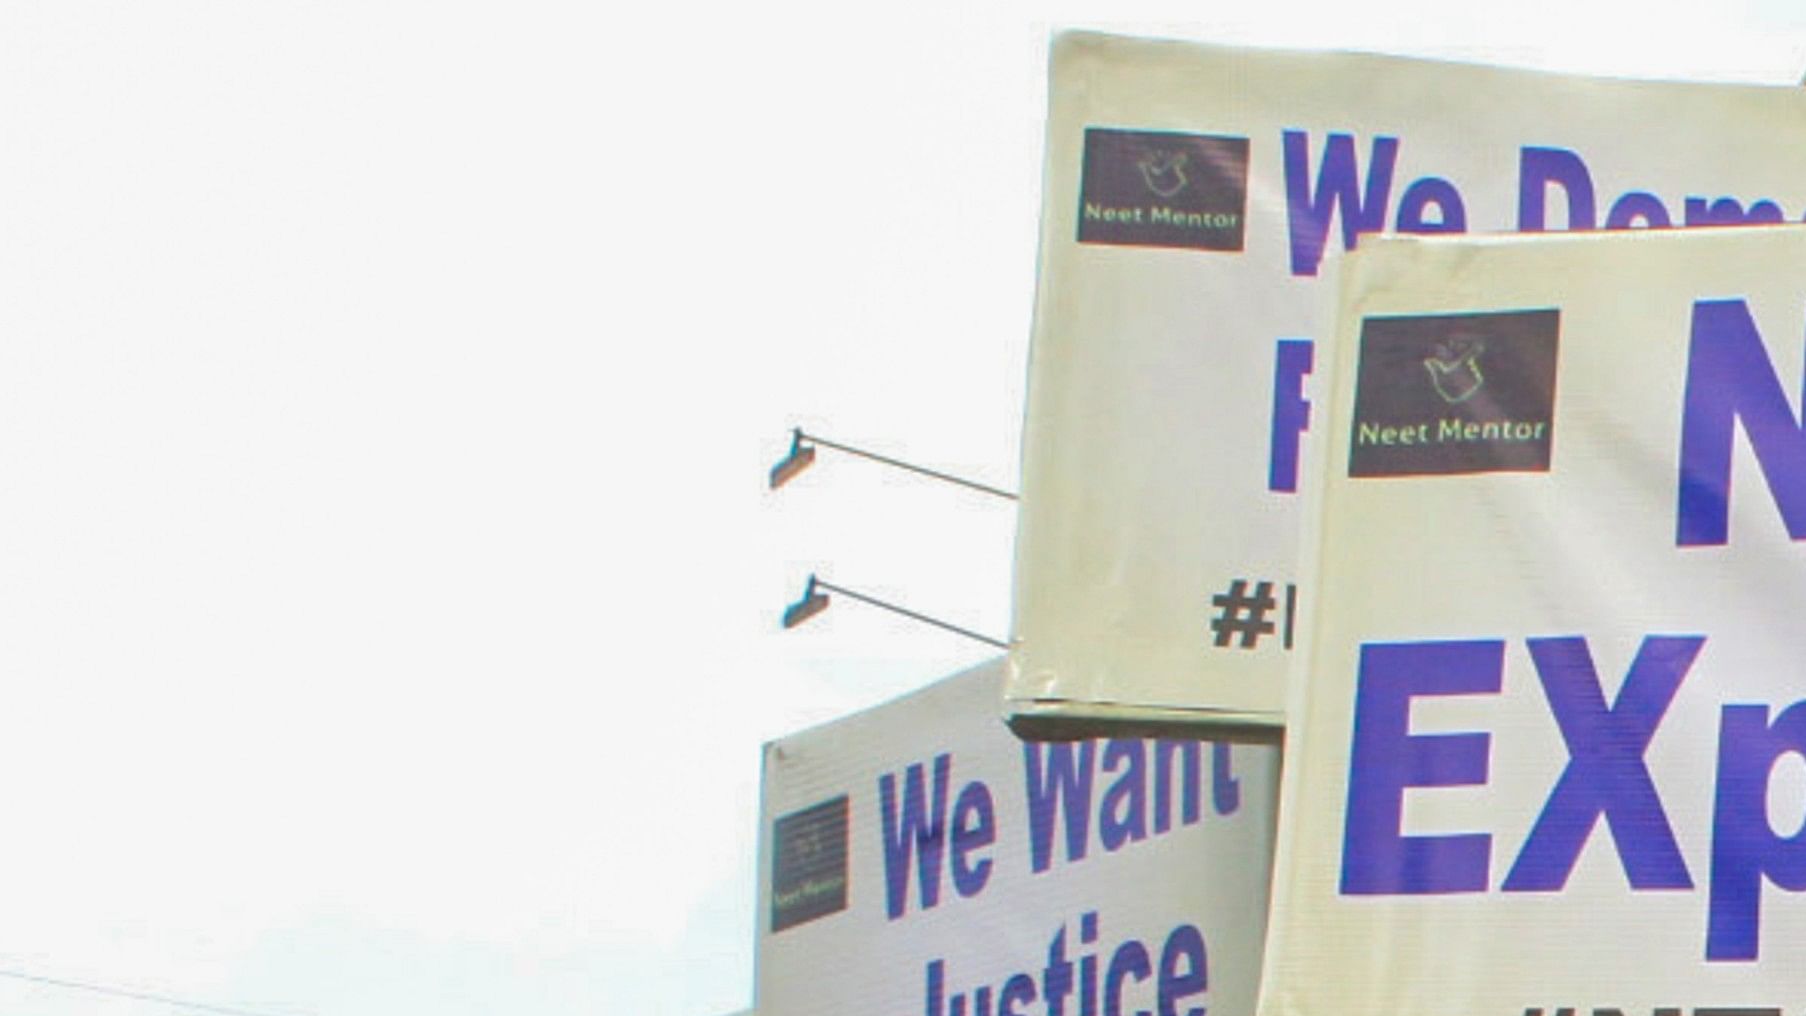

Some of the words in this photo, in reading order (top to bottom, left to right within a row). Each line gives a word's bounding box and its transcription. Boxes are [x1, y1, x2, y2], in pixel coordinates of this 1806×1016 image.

[1085, 203, 1141, 224] Neet
[1151, 206, 1238, 228] Mentor
[1359, 422, 1428, 446] Neet
[1439, 418, 1546, 443] Mentor
[879, 753, 996, 921] We
[1023, 738, 1240, 873] Want
